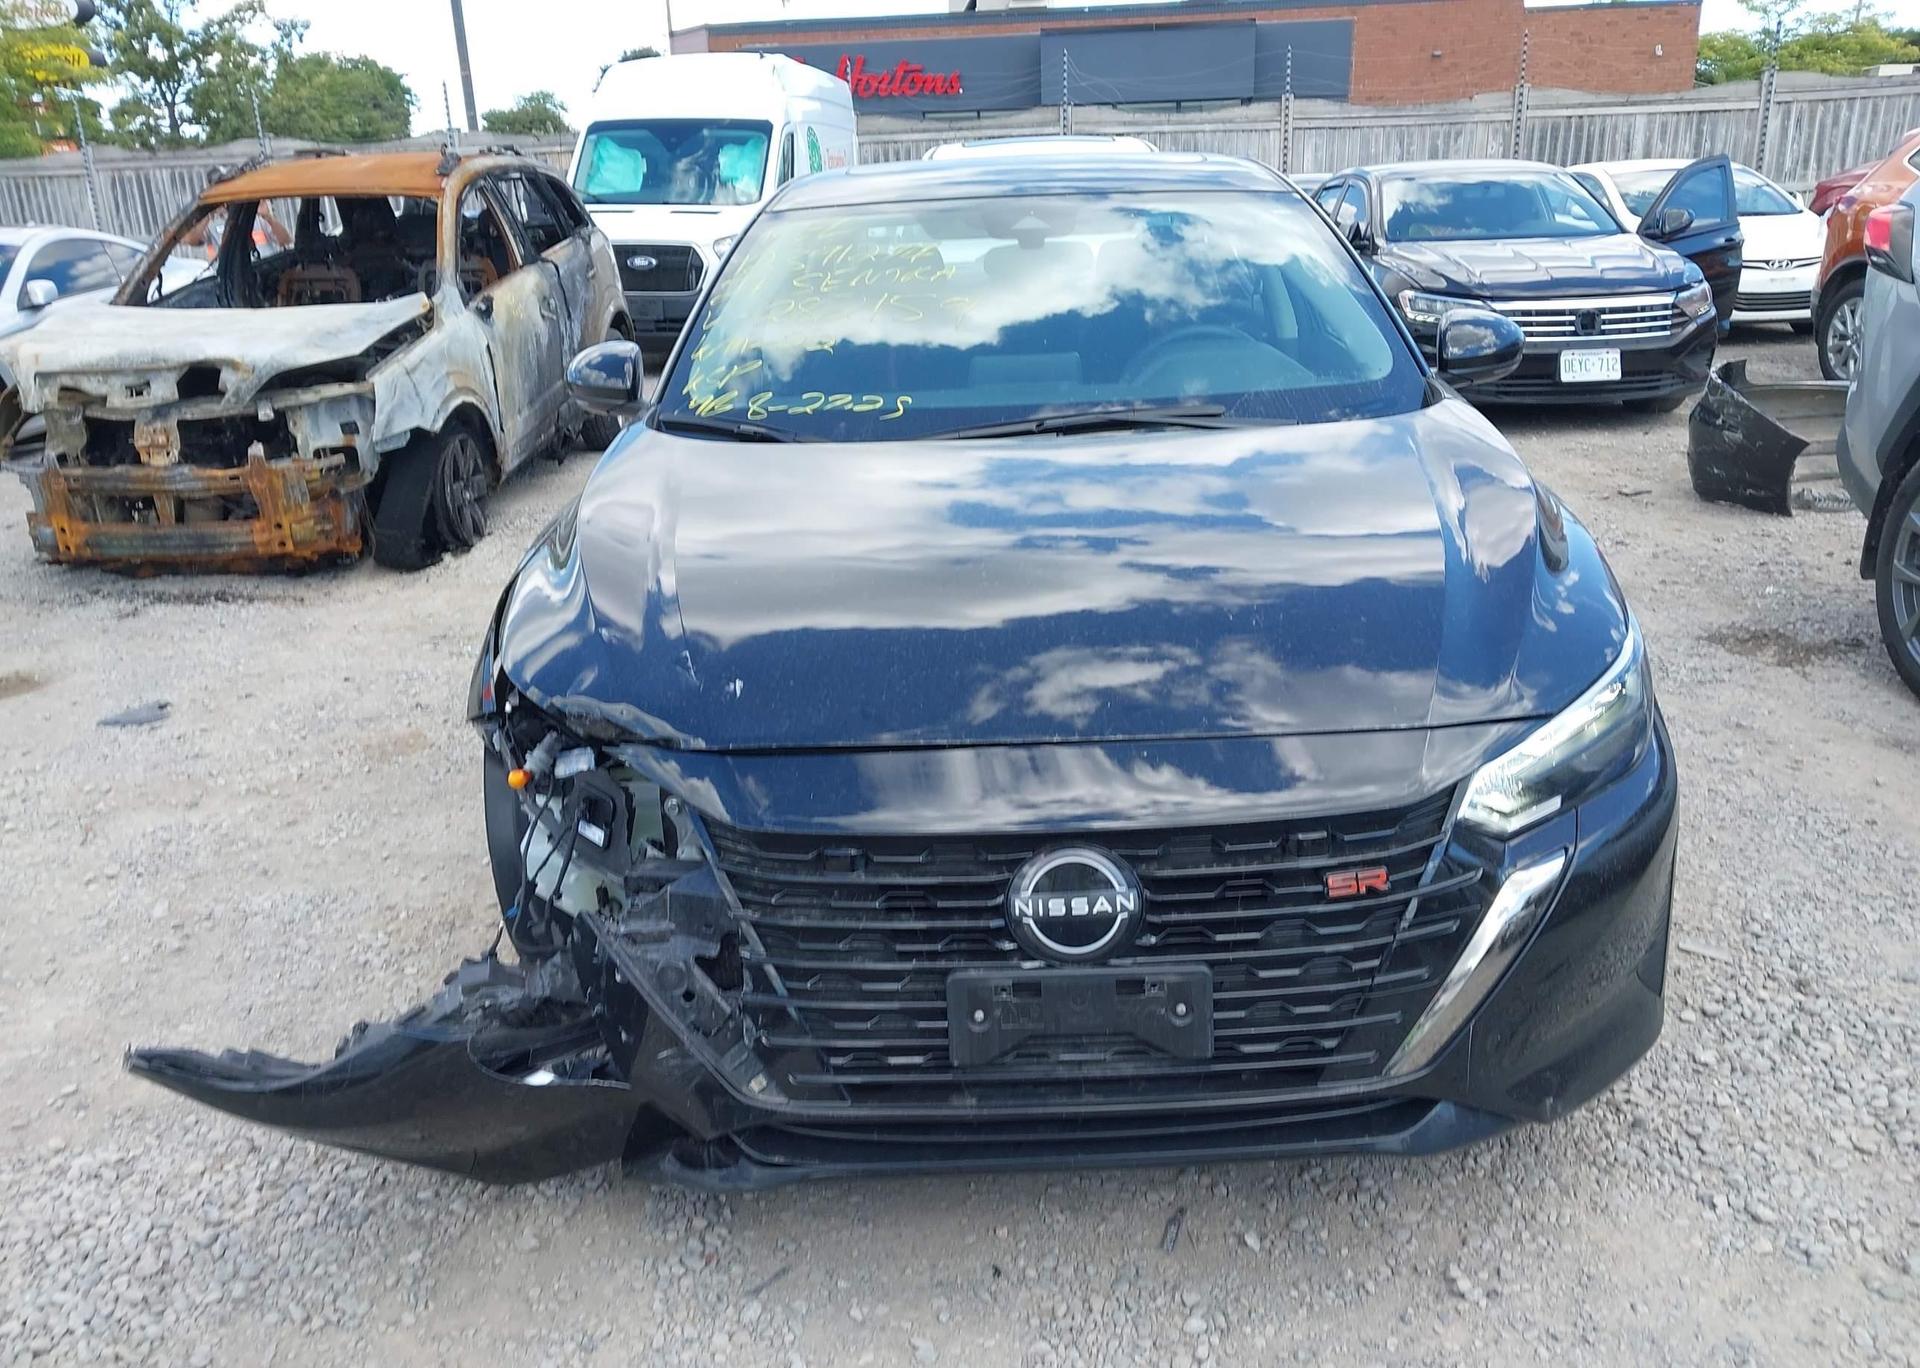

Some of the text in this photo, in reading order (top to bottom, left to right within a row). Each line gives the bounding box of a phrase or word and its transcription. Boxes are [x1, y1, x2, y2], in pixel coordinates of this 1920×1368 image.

[836, 53, 961, 98] Hortons
[1326, 867, 1389, 898] SR
[1015, 892, 1135, 917] NISSAN
